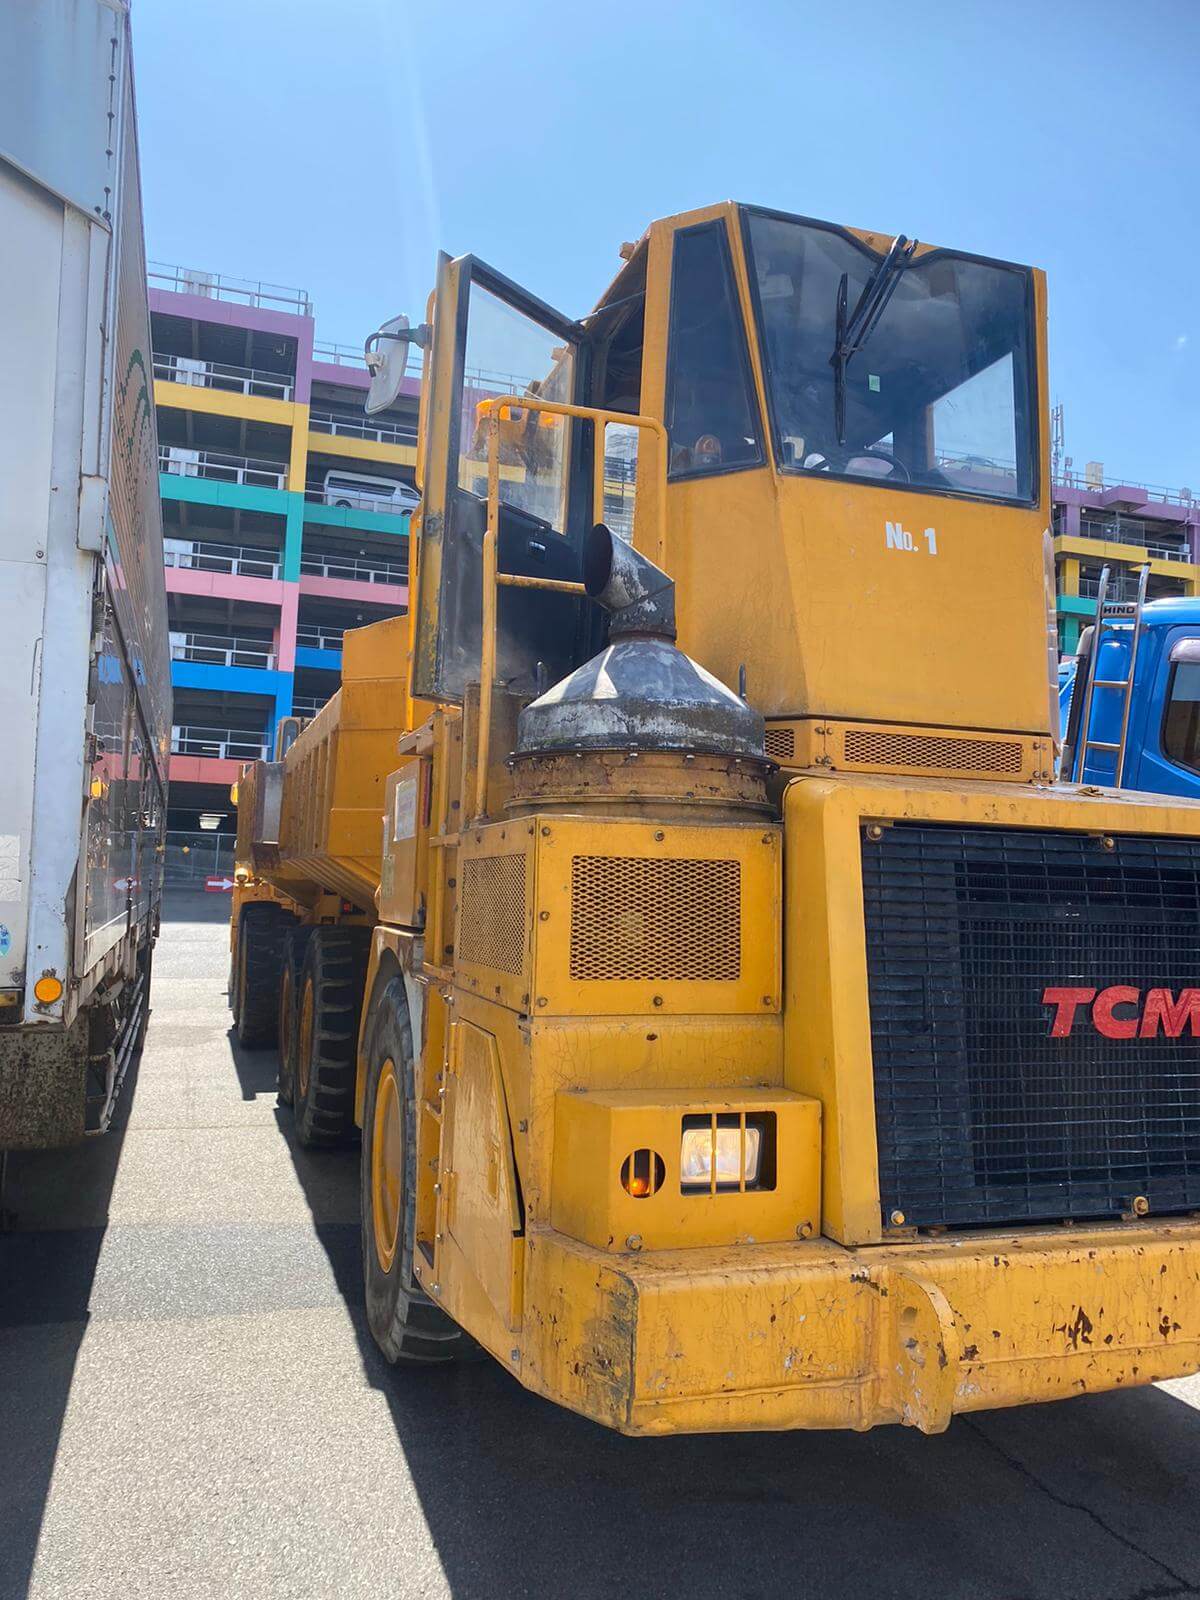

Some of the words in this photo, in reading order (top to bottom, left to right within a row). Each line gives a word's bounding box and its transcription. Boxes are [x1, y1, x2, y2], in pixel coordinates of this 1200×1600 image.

[885, 520, 919, 552] No.
[924, 527, 937, 555] 1
[1103, 605, 1136, 614] HINO
[1042, 985, 1200, 1039] TCM
